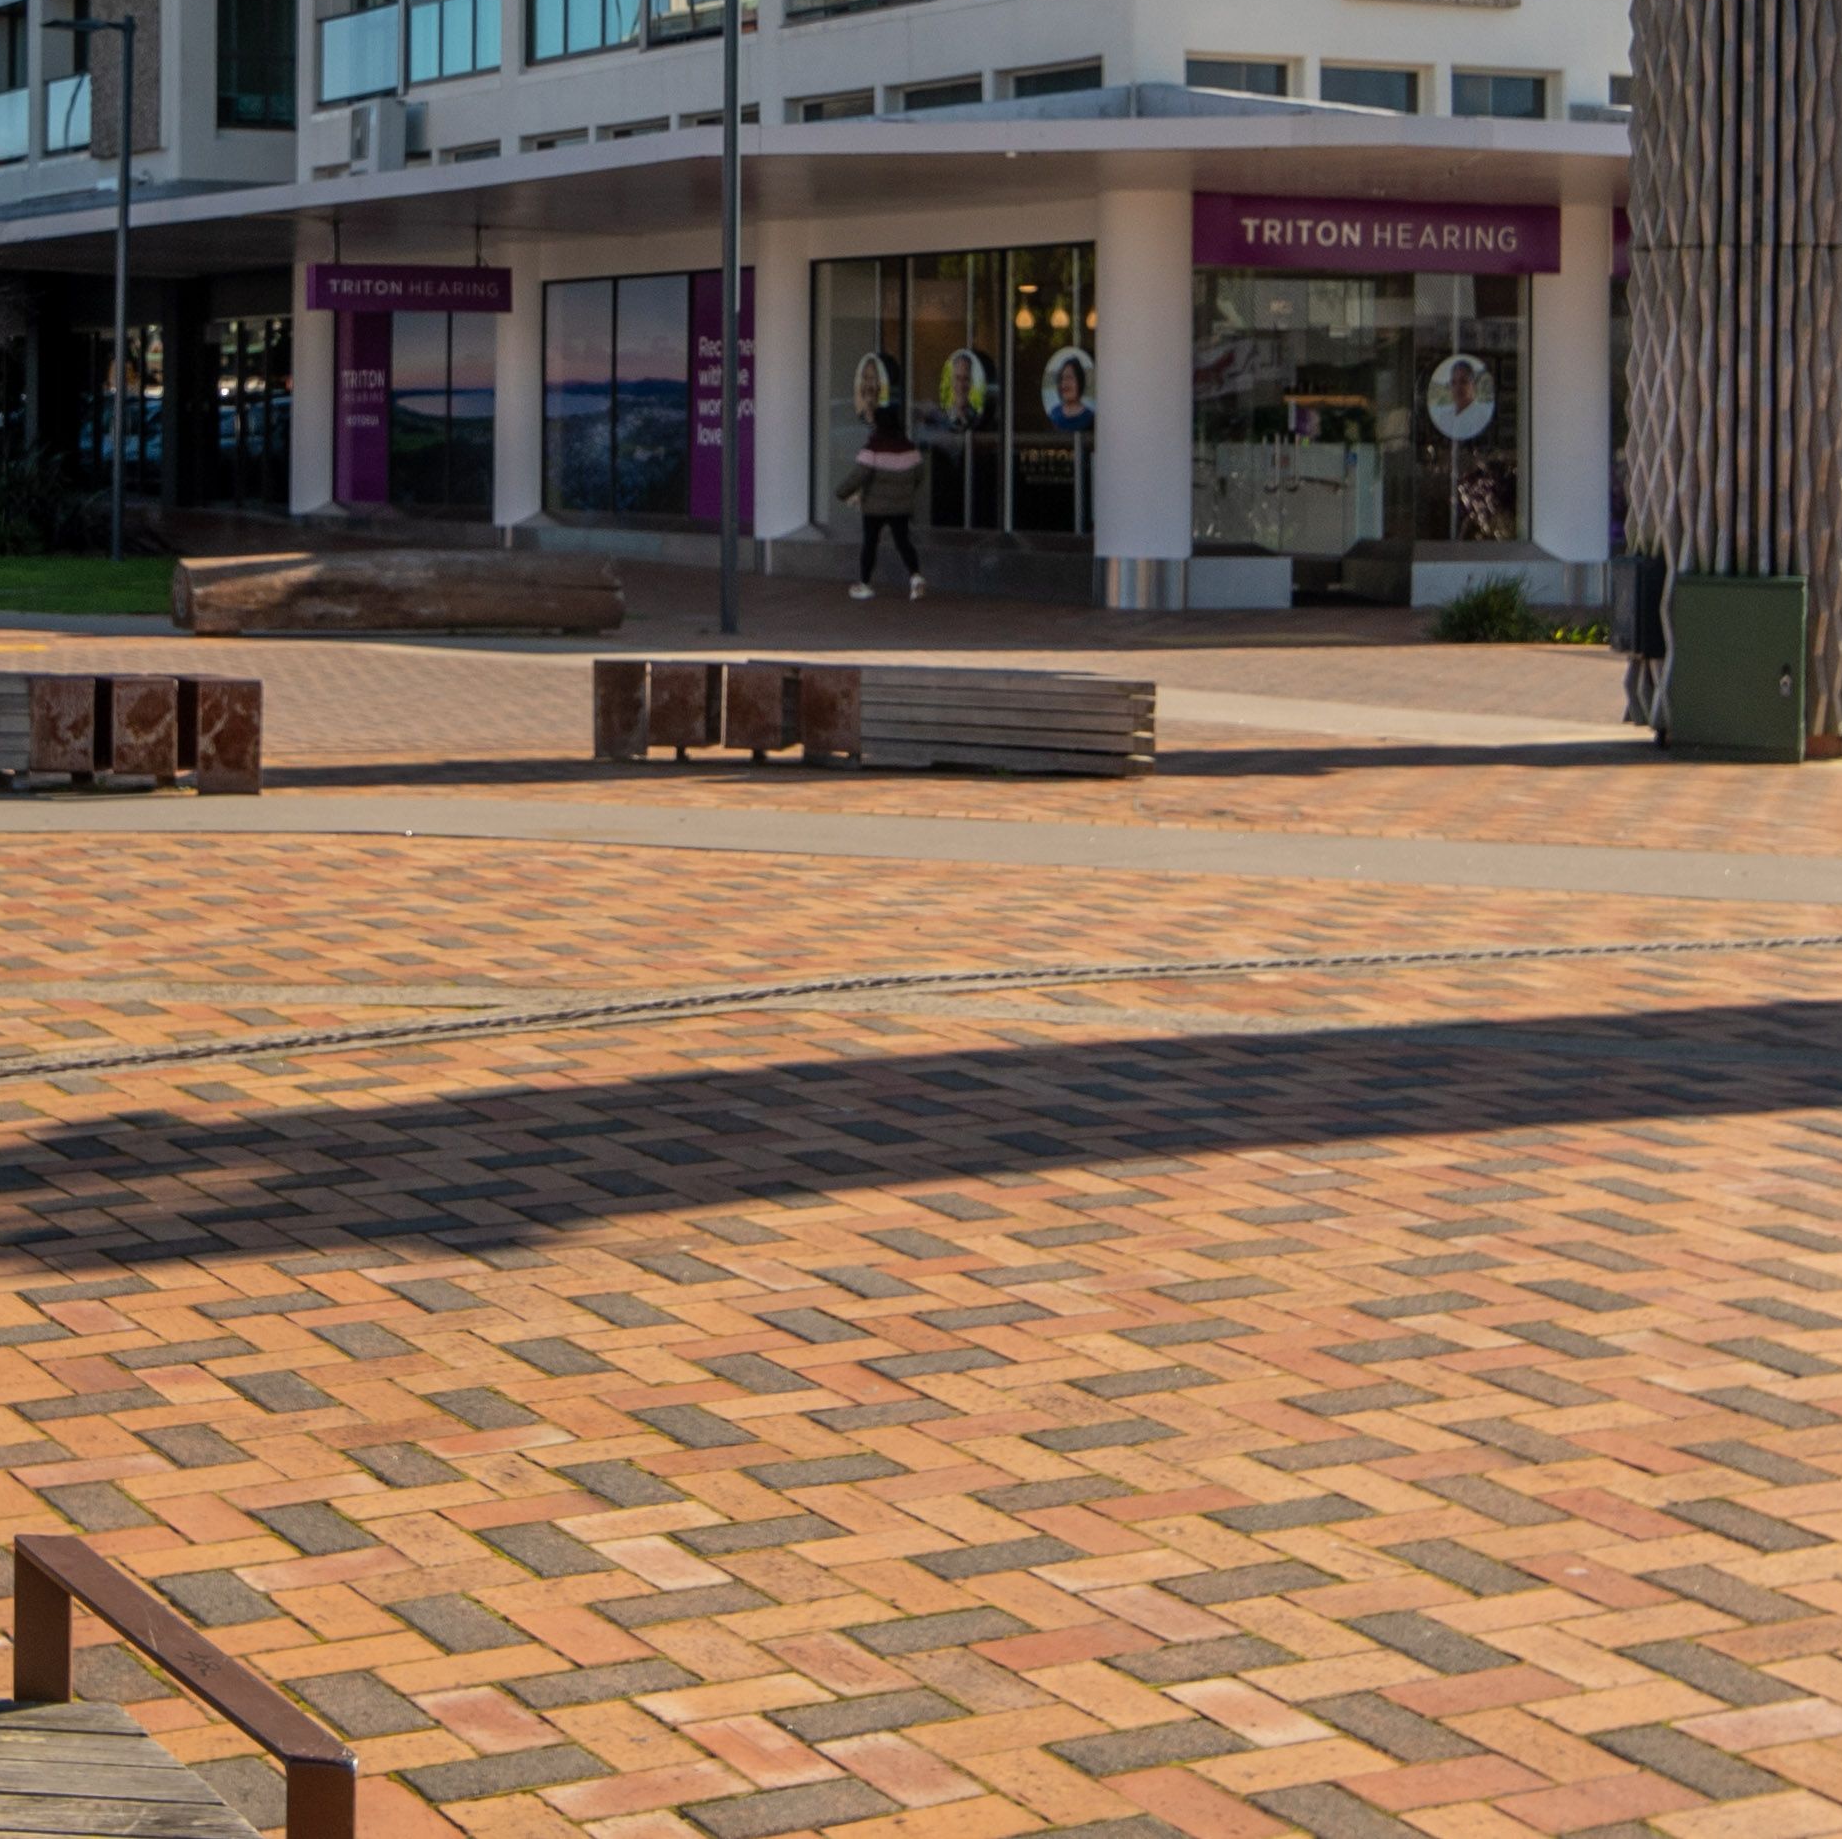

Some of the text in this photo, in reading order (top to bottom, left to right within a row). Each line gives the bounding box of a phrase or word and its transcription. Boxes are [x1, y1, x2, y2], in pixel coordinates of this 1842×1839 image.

[1240, 218, 1518, 252] TRITON HEARING
[328, 278, 499, 298] TRITON HEARING
[341, 368, 386, 389] TRITON
